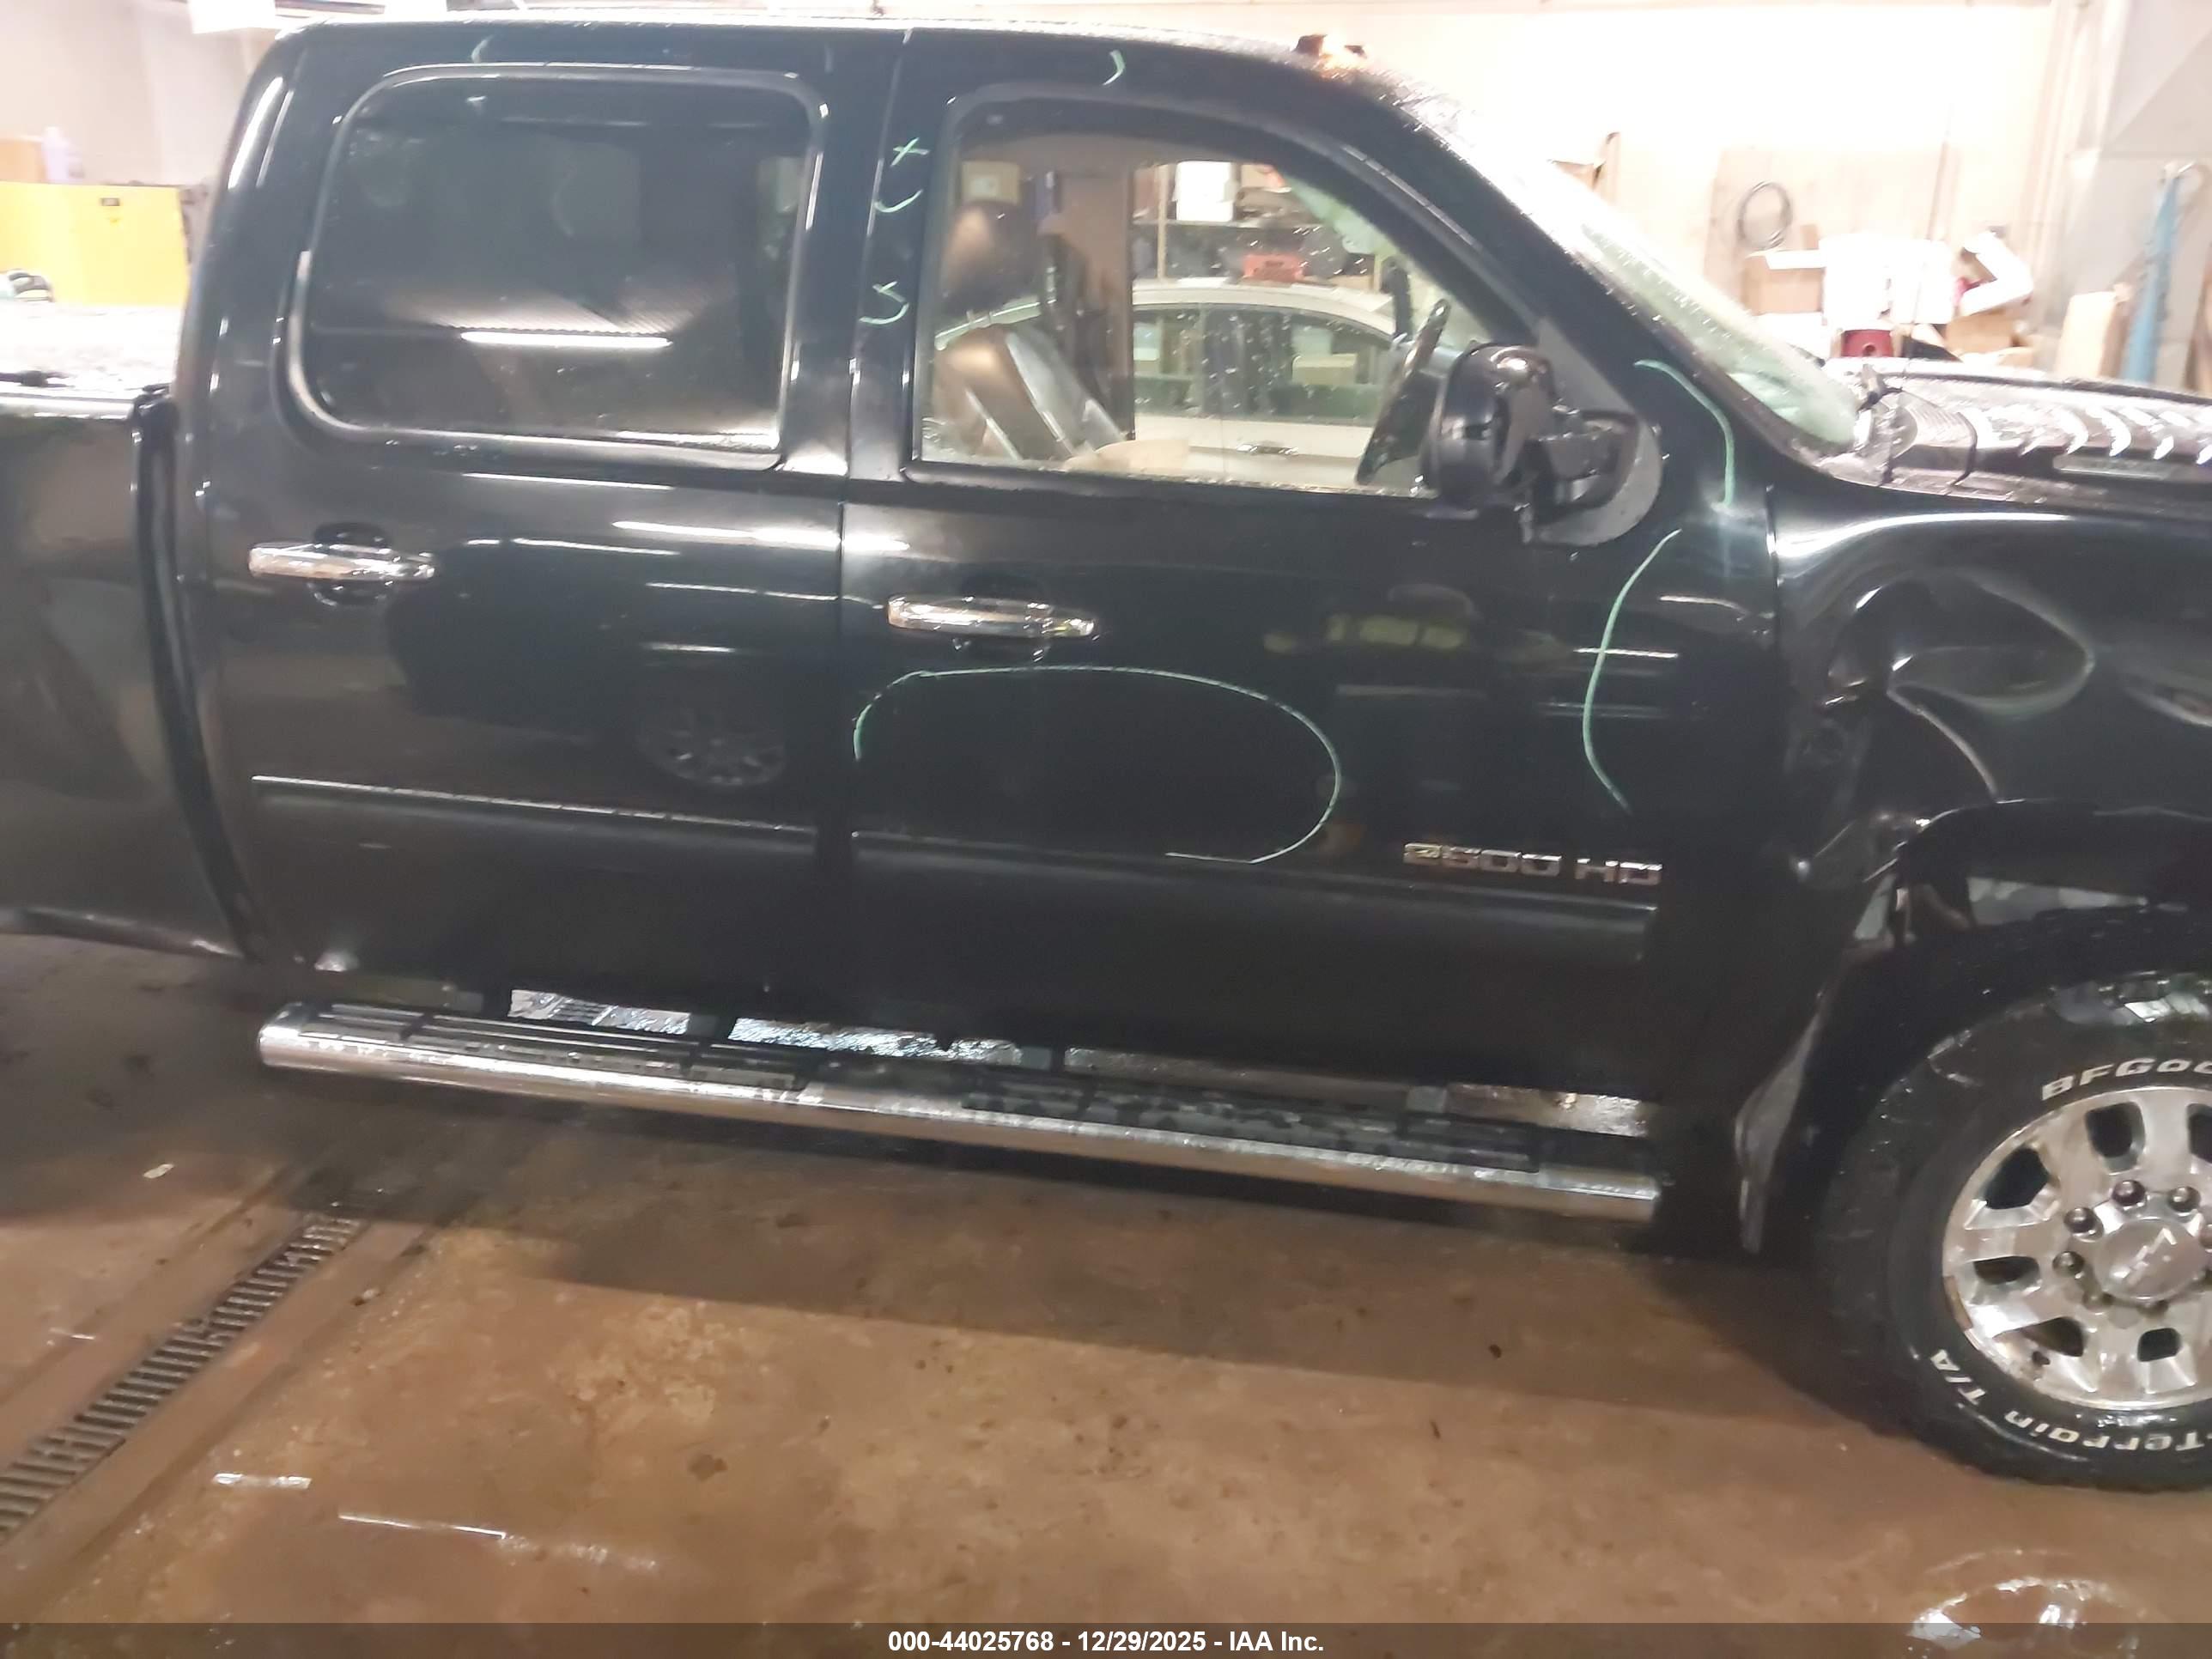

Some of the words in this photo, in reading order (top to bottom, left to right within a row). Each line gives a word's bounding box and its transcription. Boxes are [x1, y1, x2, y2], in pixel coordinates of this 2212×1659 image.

[1402, 842, 1563, 878] 2500
[1574, 858, 1663, 886] HD
[1929, 1348, 1986, 1407] T/A
